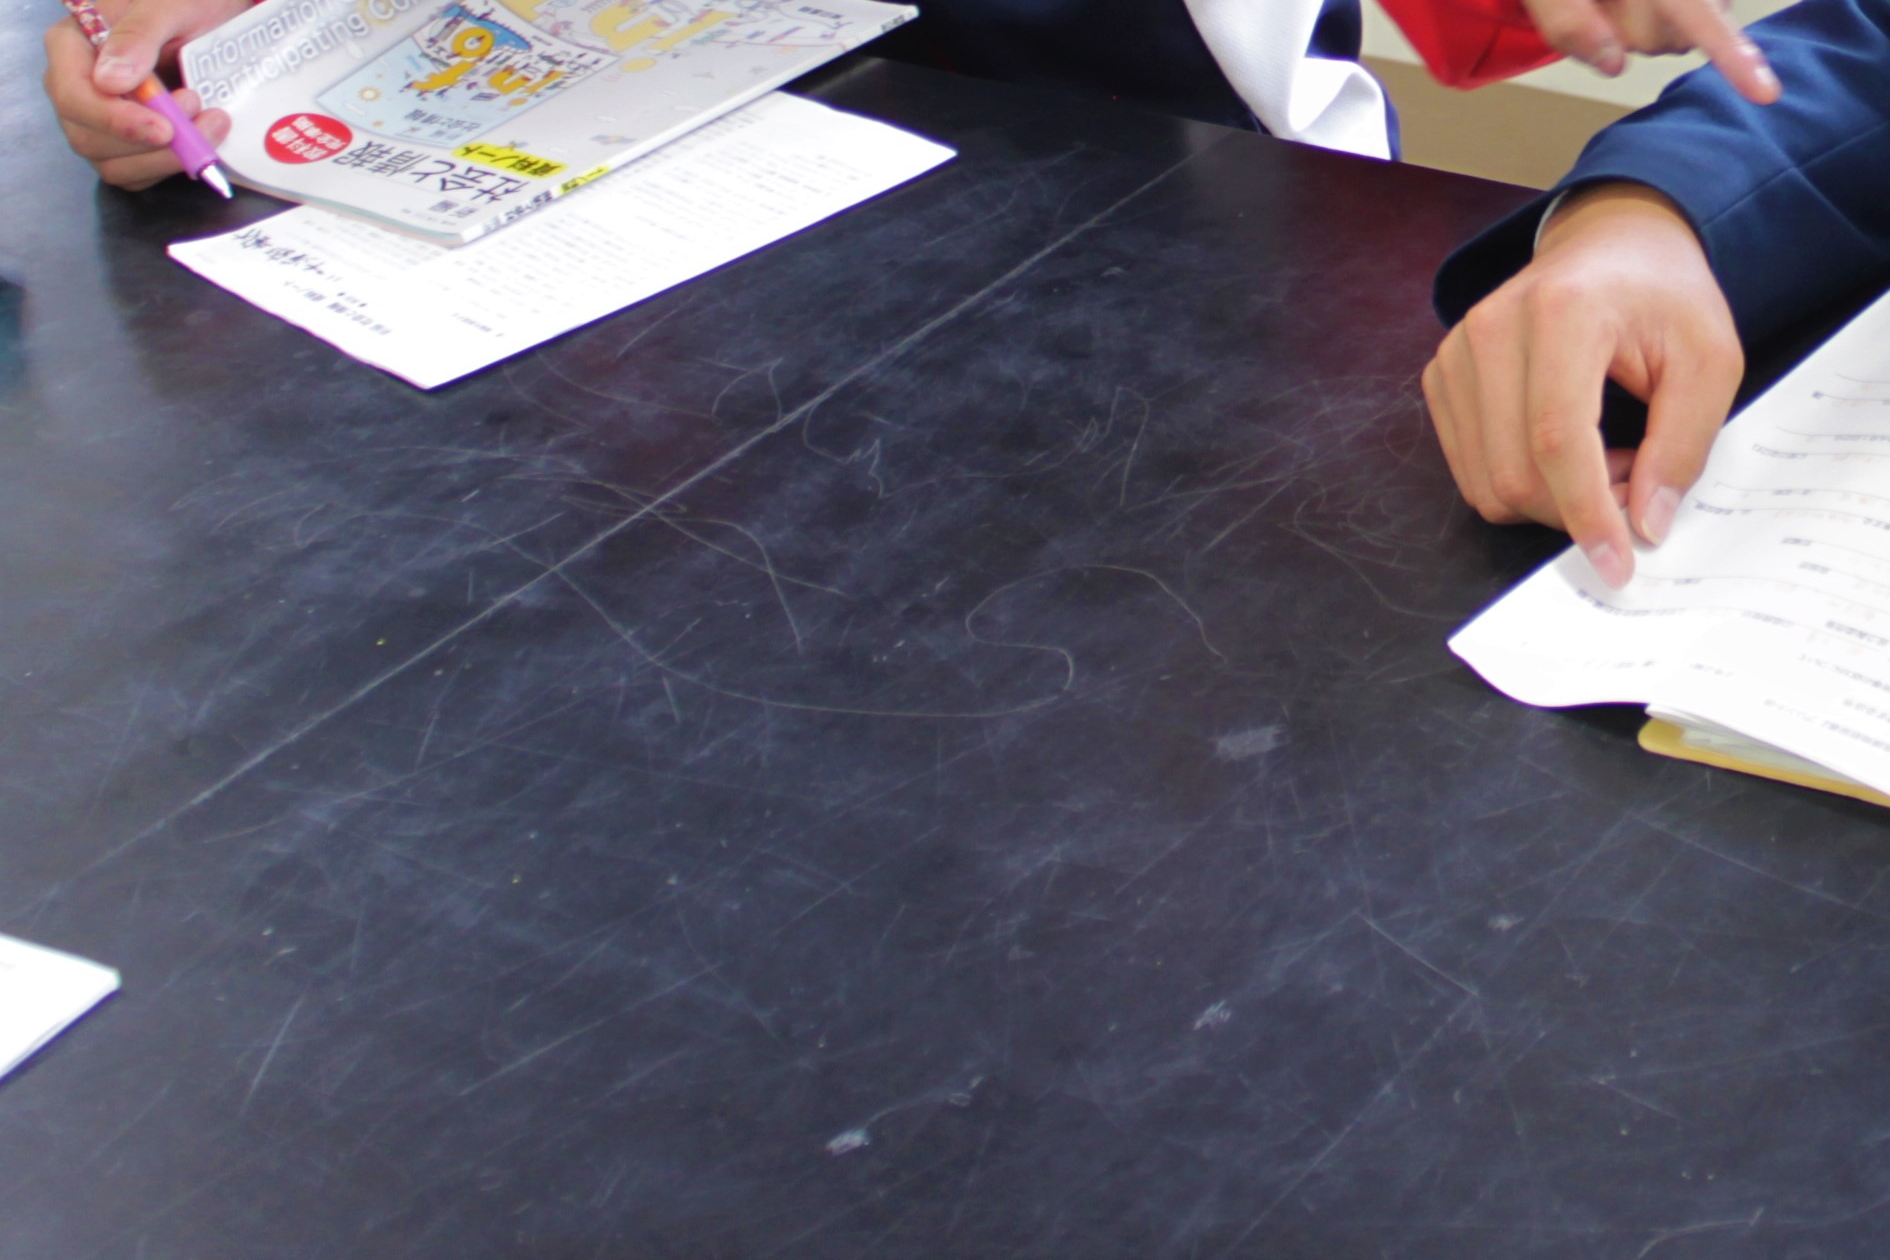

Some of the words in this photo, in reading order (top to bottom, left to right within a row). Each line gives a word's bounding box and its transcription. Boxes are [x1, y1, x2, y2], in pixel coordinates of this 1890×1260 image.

[196, 13, 368, 108] Participating
[332, 139, 530, 205] 社会と情報
[455, 144, 557, 177] 資料ノート
